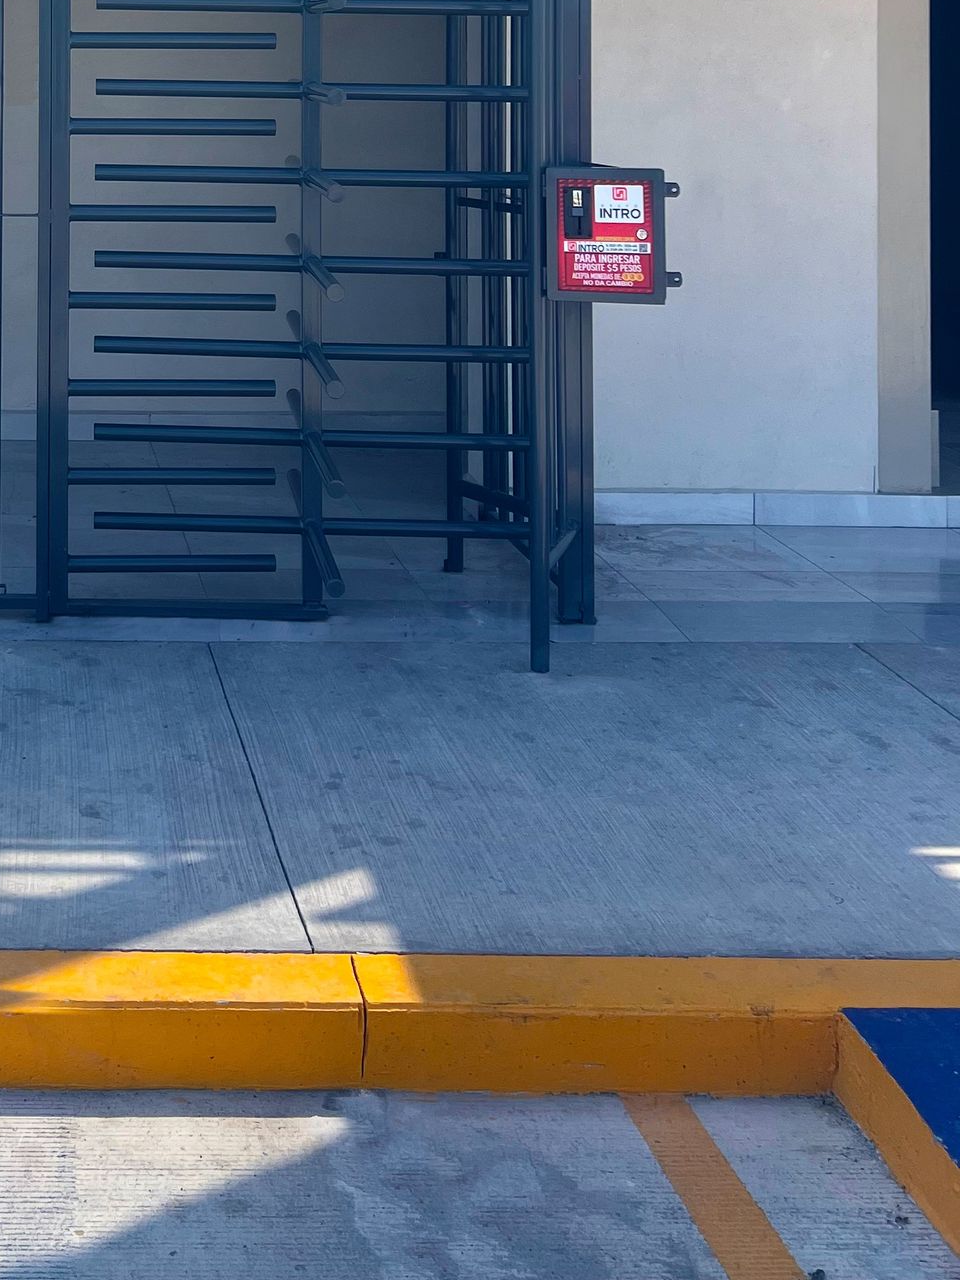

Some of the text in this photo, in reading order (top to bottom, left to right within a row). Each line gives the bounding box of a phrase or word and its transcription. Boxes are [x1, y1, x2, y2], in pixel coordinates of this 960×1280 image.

[599, 208, 641, 219] INTRO
[578, 244, 604, 253] INTRO
[574, 254, 640, 264] PARA INGRESAR
[573, 263, 606, 272] DEPOSITE
[620, 264, 642, 273] PESOS
